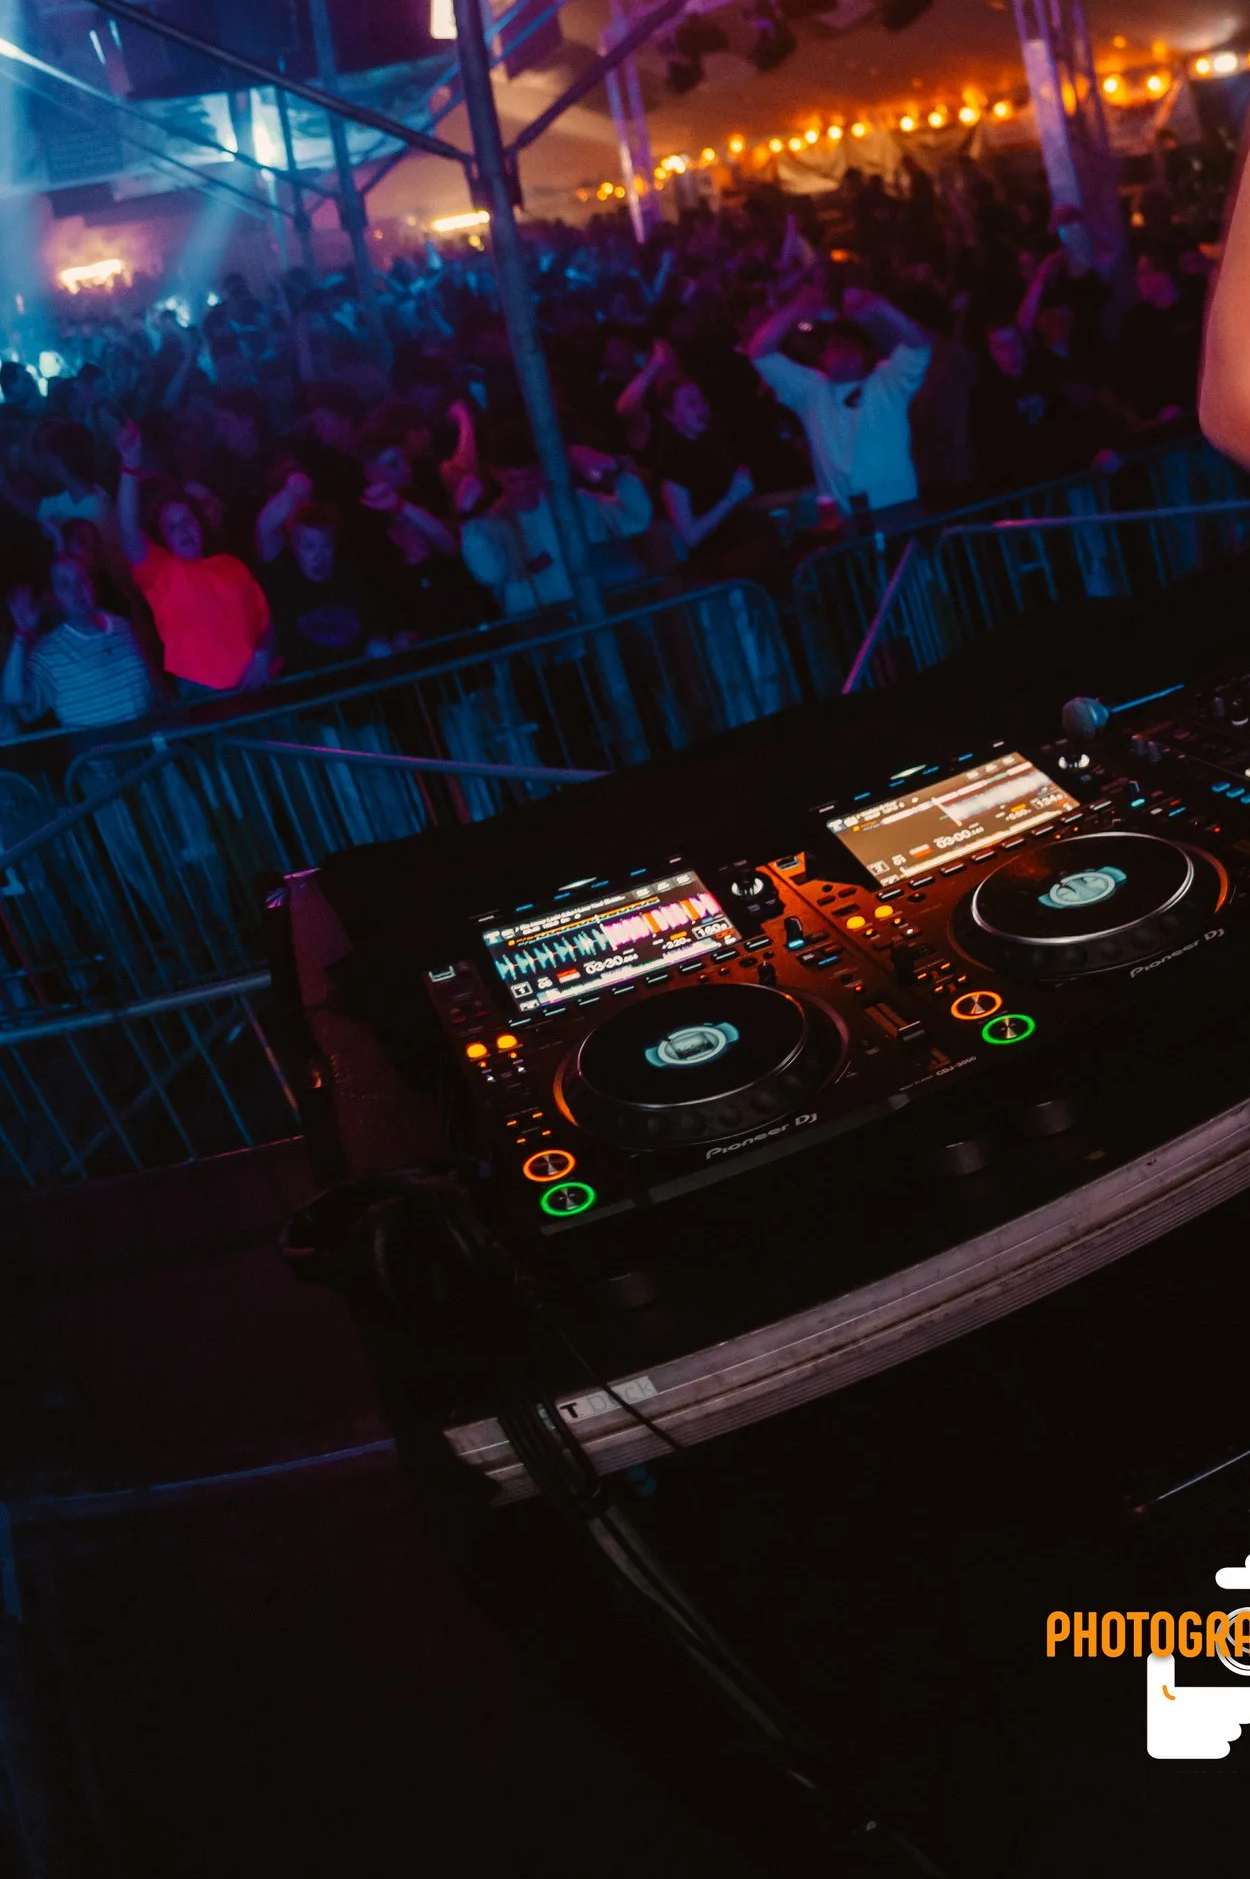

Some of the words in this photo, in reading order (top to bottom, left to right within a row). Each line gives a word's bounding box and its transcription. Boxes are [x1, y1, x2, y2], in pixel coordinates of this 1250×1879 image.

[1129, 939, 1201, 979] Pioneer
[1203, 927, 1226, 942] DJ
[705, 1122, 791, 1161] Pioneer
[795, 1112, 819, 1127] DJ
